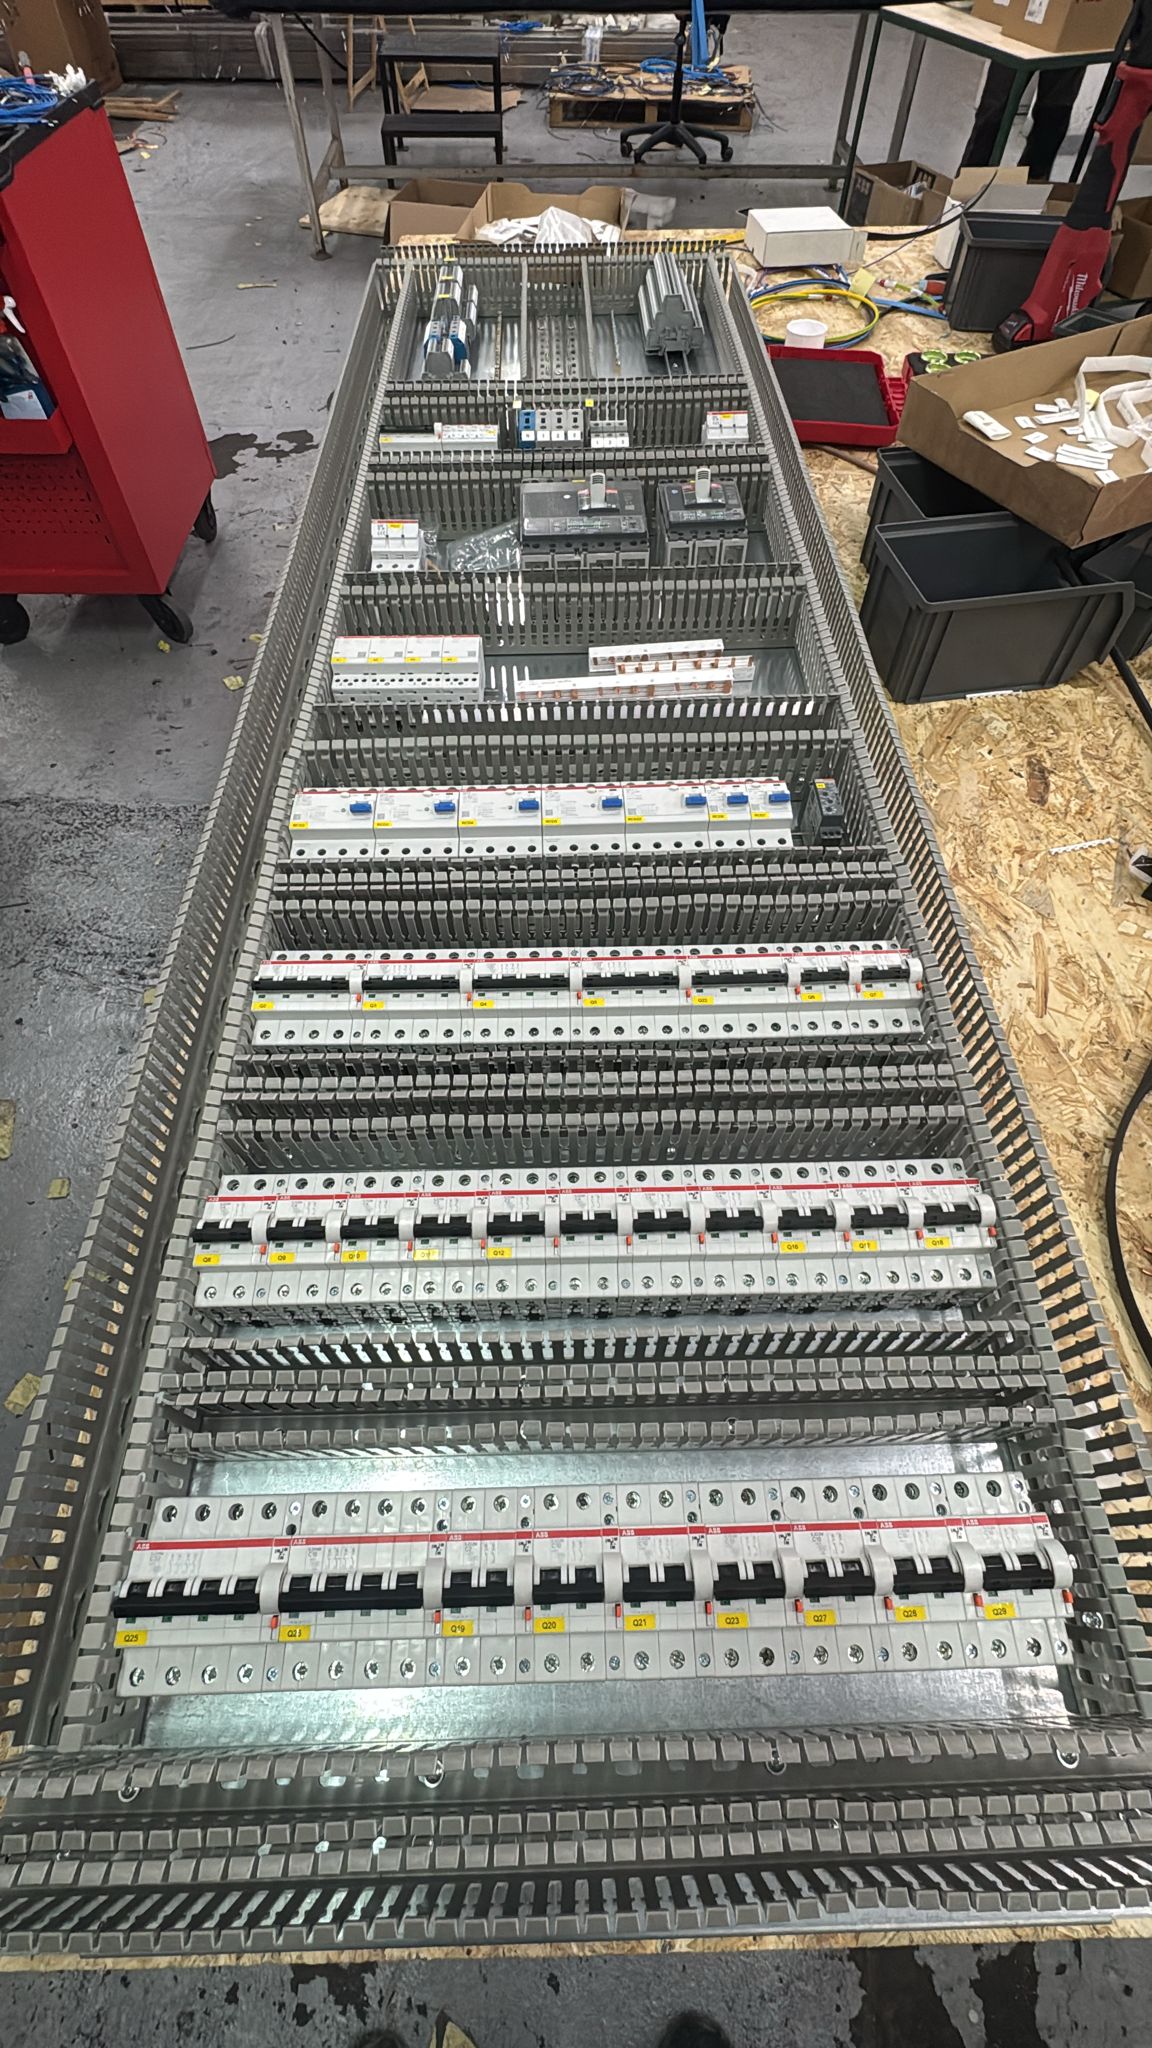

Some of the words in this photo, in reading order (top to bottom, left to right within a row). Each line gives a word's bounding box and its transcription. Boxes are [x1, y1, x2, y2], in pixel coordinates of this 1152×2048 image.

[903, 1609, 918, 1618] Q28
[992, 1607, 1007, 1616] Q29
[633, 1618, 647, 1627] Q21
[725, 1616, 740, 1625] Q23
[813, 1614, 827, 1623] Q27
[451, 1624, 465, 1633] Q19
[542, 1621, 557, 1630] Q20
[124, 1634, 139, 1643] Q25
